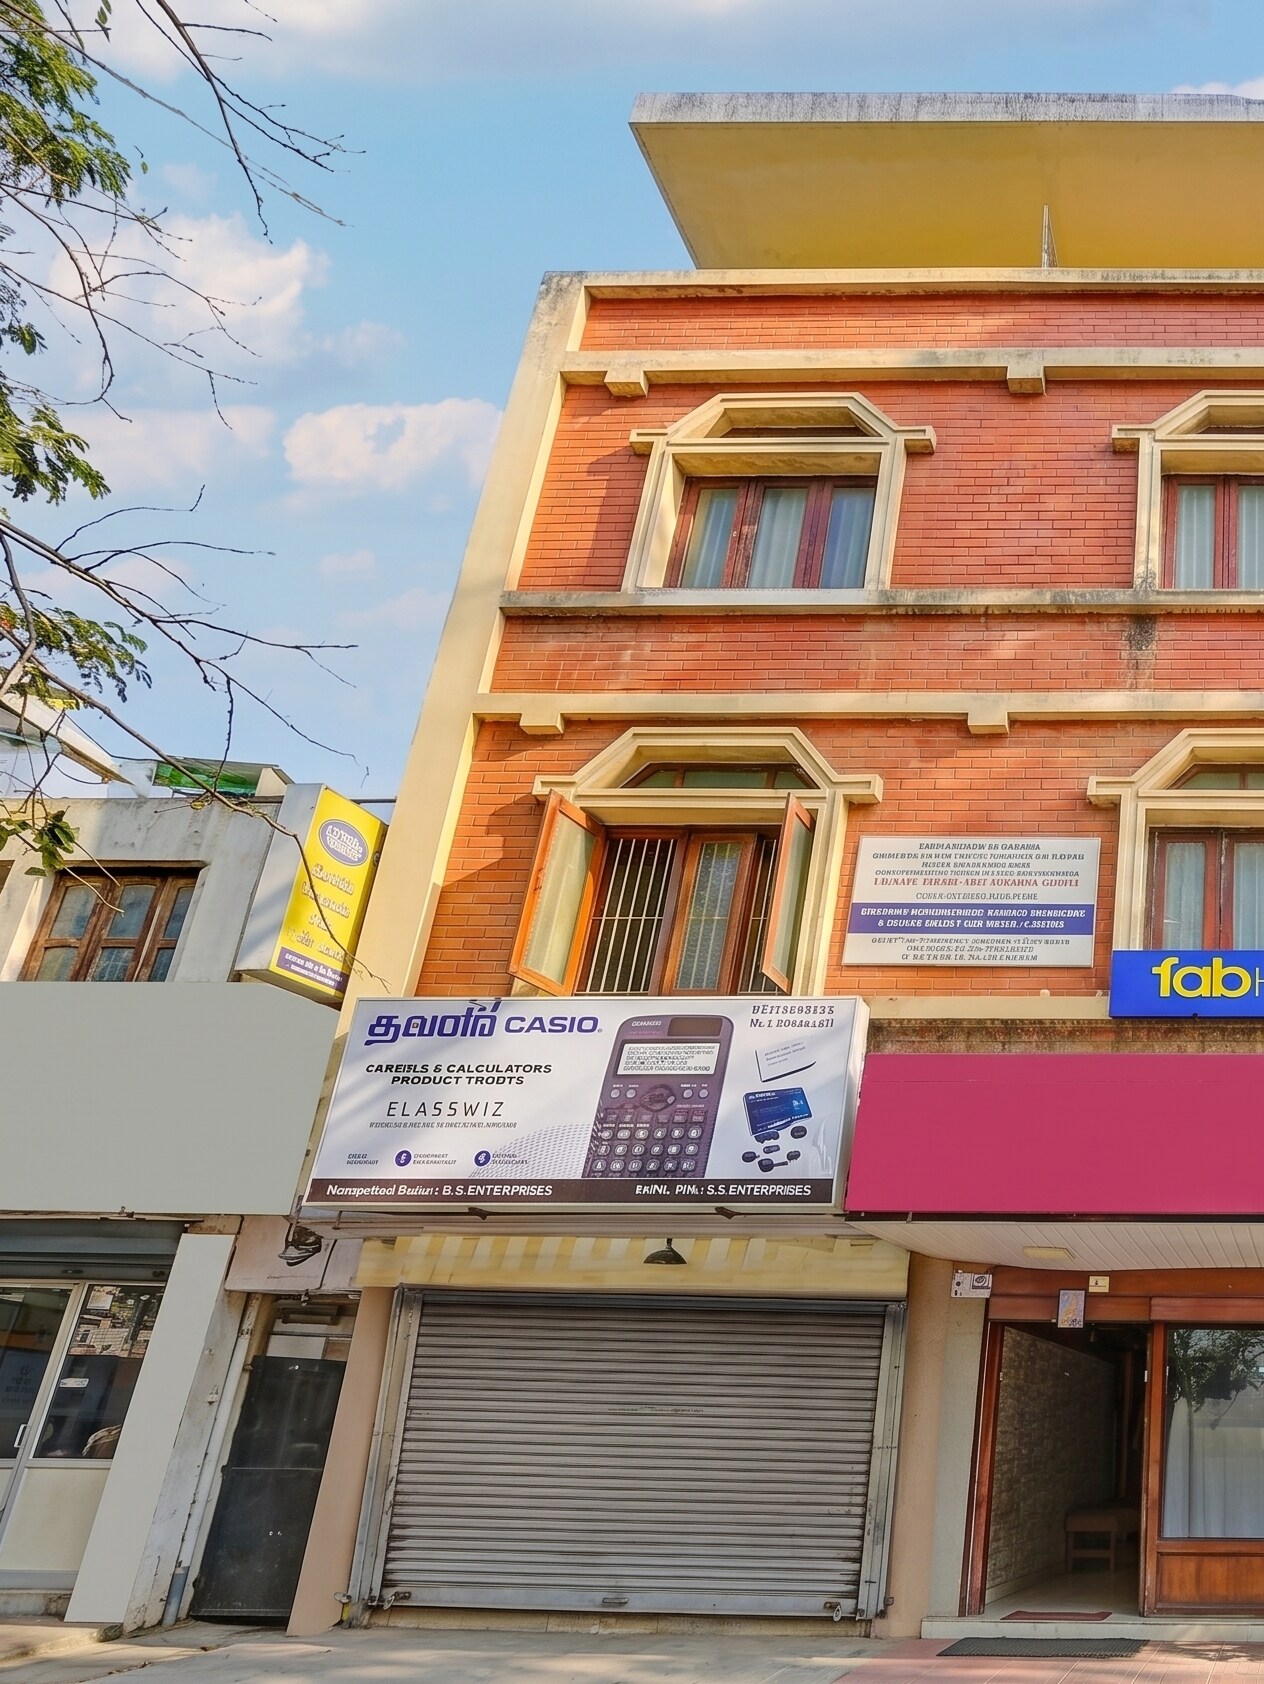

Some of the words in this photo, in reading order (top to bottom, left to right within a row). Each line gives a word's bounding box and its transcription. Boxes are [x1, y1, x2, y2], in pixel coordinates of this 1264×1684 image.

[504, 1016, 599, 1034] CASIO
[433, 1064, 442, 1073] &
[446, 1064, 552, 1074] CALCULATORS
[391, 1076, 462, 1085] PRODUCT
